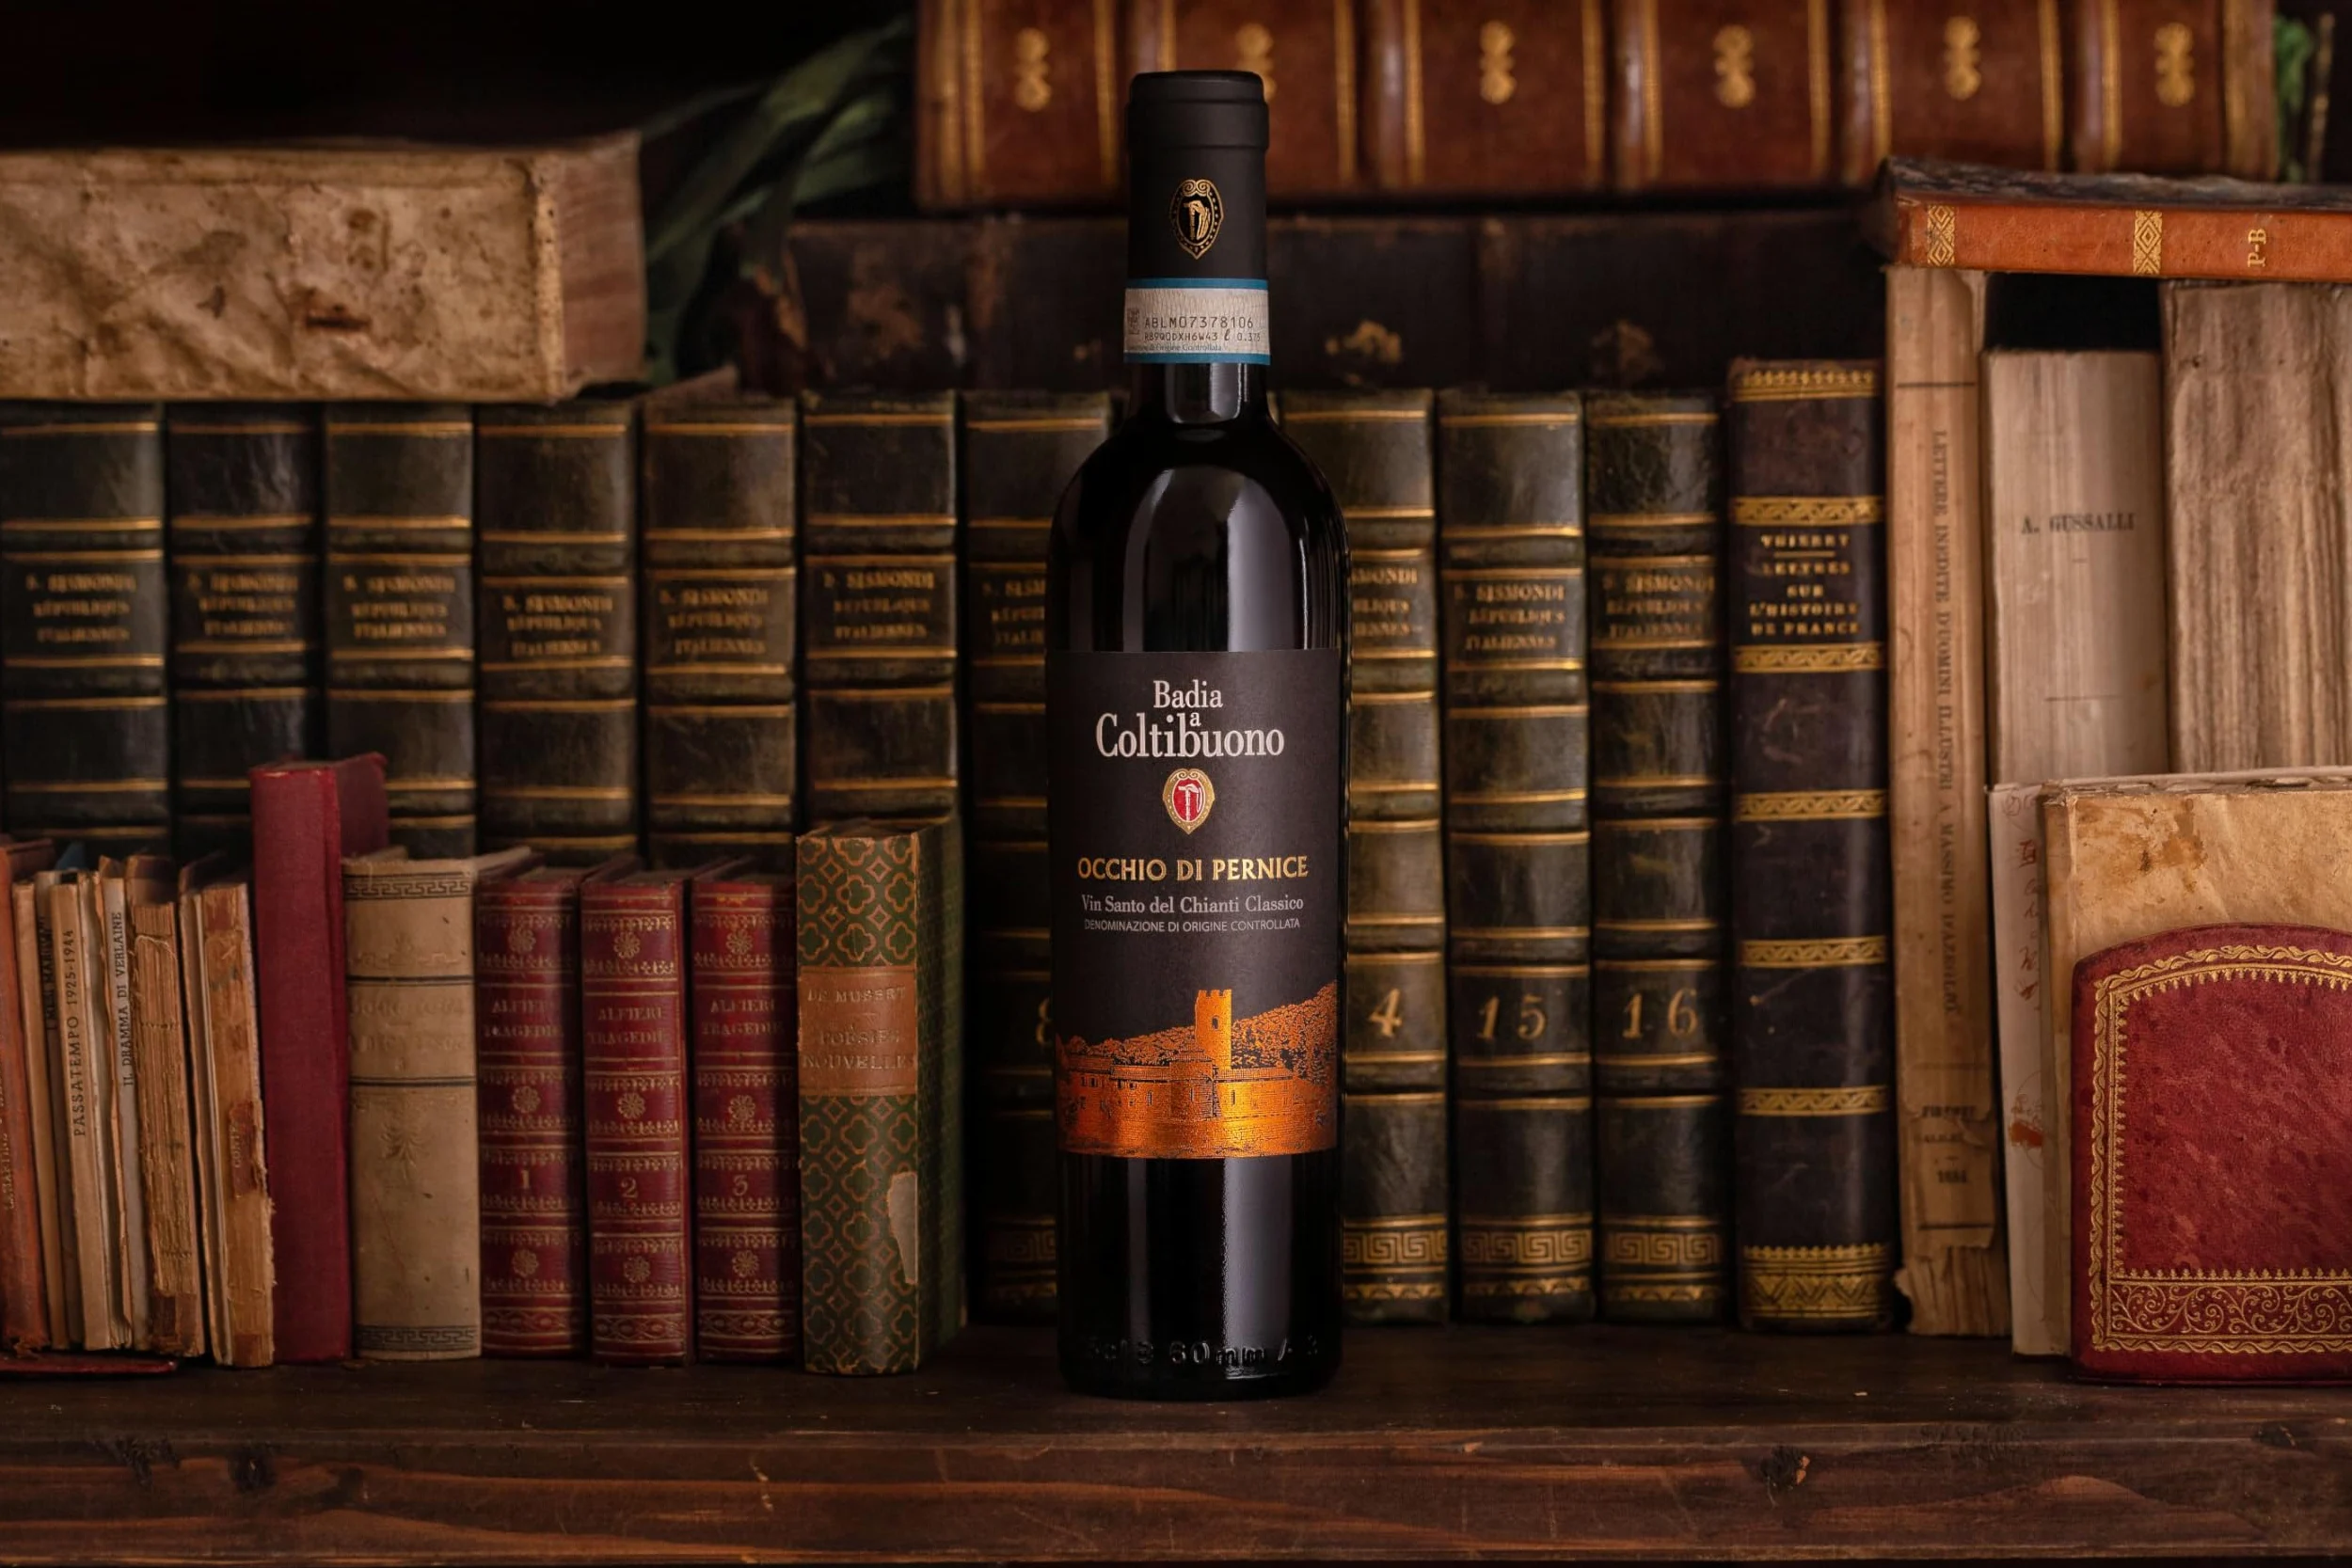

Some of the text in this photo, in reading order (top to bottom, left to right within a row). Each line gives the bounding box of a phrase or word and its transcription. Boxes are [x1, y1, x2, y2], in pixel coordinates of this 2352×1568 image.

[1153, 679, 1223, 708] Badia
[1189, 711, 1201, 727] a
[1096, 713, 1285, 757] Coltibuono
[1078, 856, 1309, 881] OCCHIO DI PERNICE
[1082, 895, 1304, 913] Vin Santo del Chianti Classico
[1085, 918, 1300, 932] DENOMINAZIONE DI ORIGINE CONTROLLATA
[111, 912, 135, 1086] IL DRAMMA DI VERLAINE
[1478, 993, 1546, 1040] 15
[1621, 988, 1698, 1039] 16
[66, 1016, 86, 1136] PASSATEMPO
[620, 1177, 638, 1198] 2
[732, 1175, 749, 1196] 3
